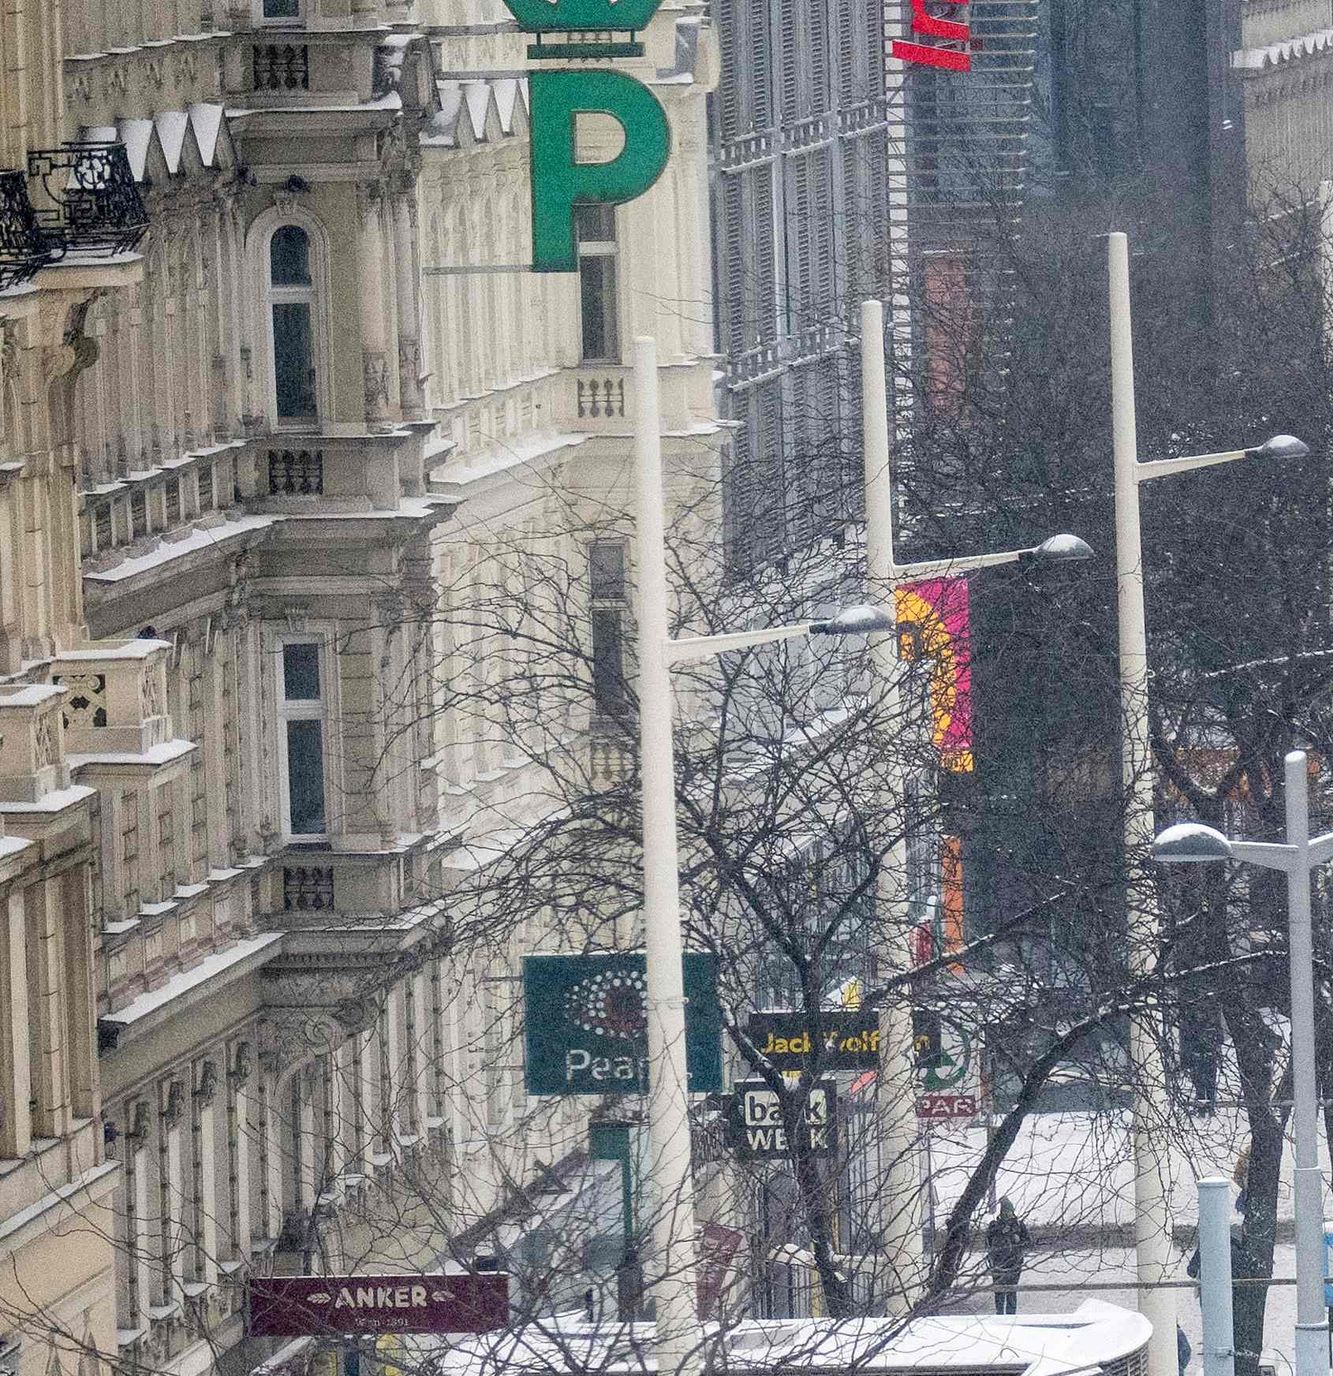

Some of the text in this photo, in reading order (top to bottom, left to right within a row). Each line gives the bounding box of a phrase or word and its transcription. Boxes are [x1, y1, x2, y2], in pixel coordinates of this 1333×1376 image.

[529, 69, 670, 272] P
[749, 1094, 822, 1122] bak
[747, 1128, 828, 1151] WEK
[334, 1285, 428, 1309] ANKER
